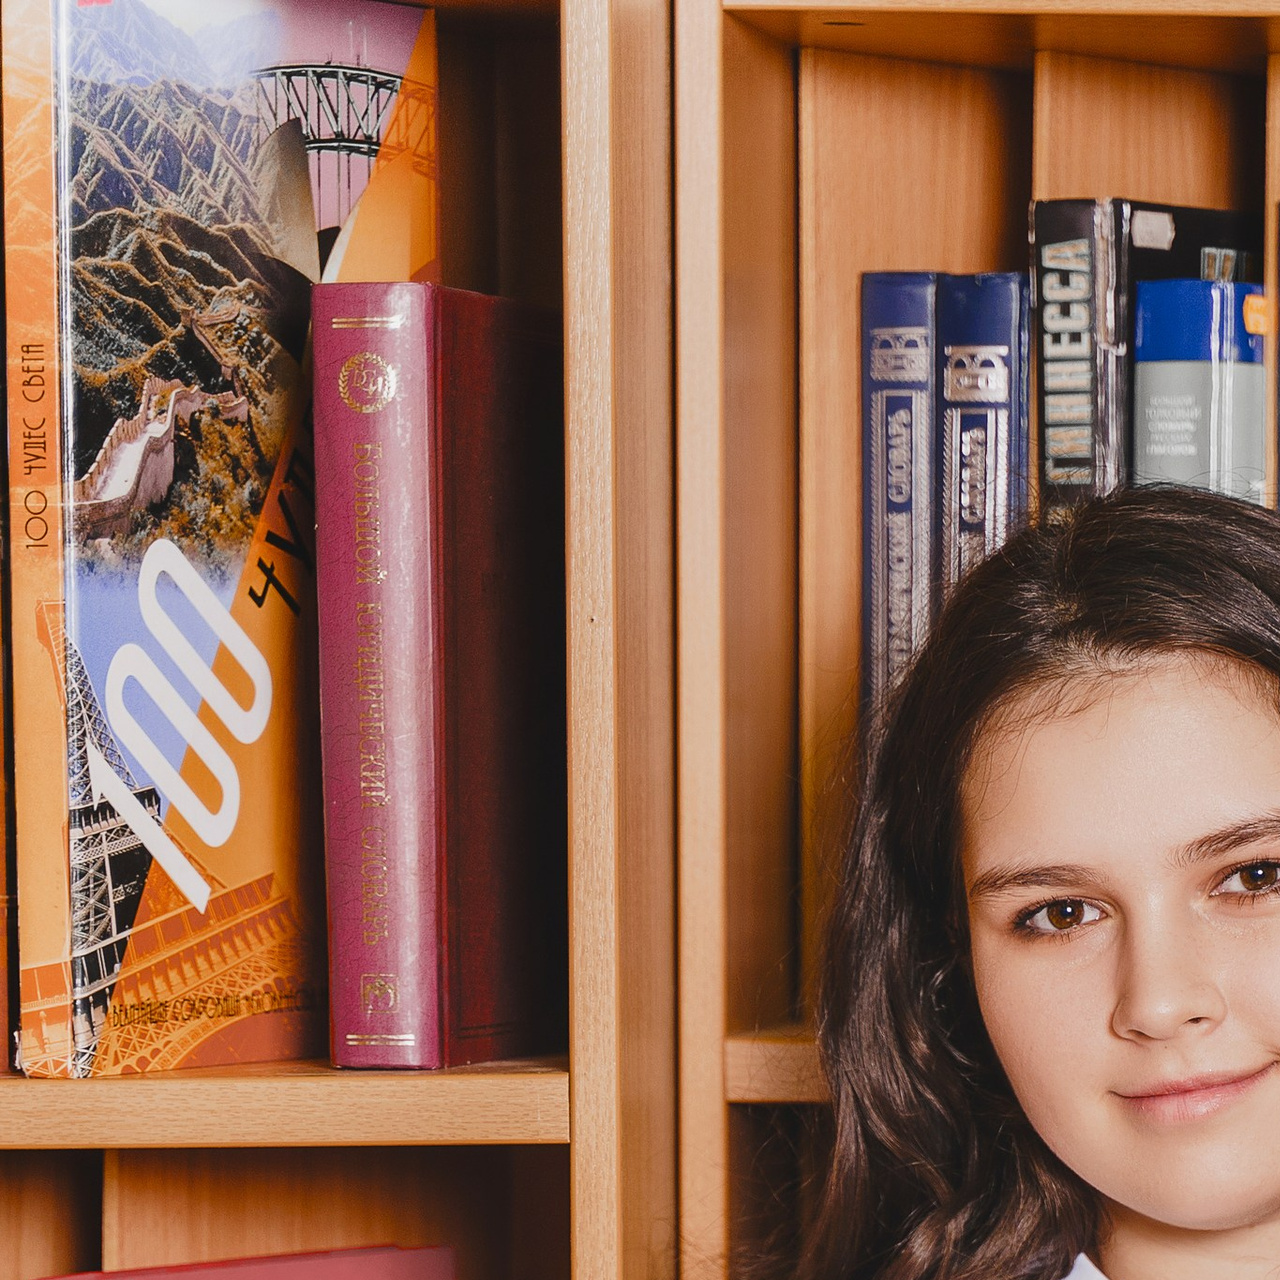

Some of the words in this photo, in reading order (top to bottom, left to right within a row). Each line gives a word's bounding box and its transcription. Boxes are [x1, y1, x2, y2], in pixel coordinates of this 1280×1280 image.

[21, 343, 46, 403] СВЕТА
[23, 417, 47, 476] ЧУДЕС
[24, 490, 49, 549] 100
[353, 441, 388, 586] БОЛЬШОЙ
[85, 538, 273, 915] 100
[356, 600, 391, 809] ЮРИДИЧЕСКИЙ
[360, 825, 390, 947] СЛОВАРЬ
